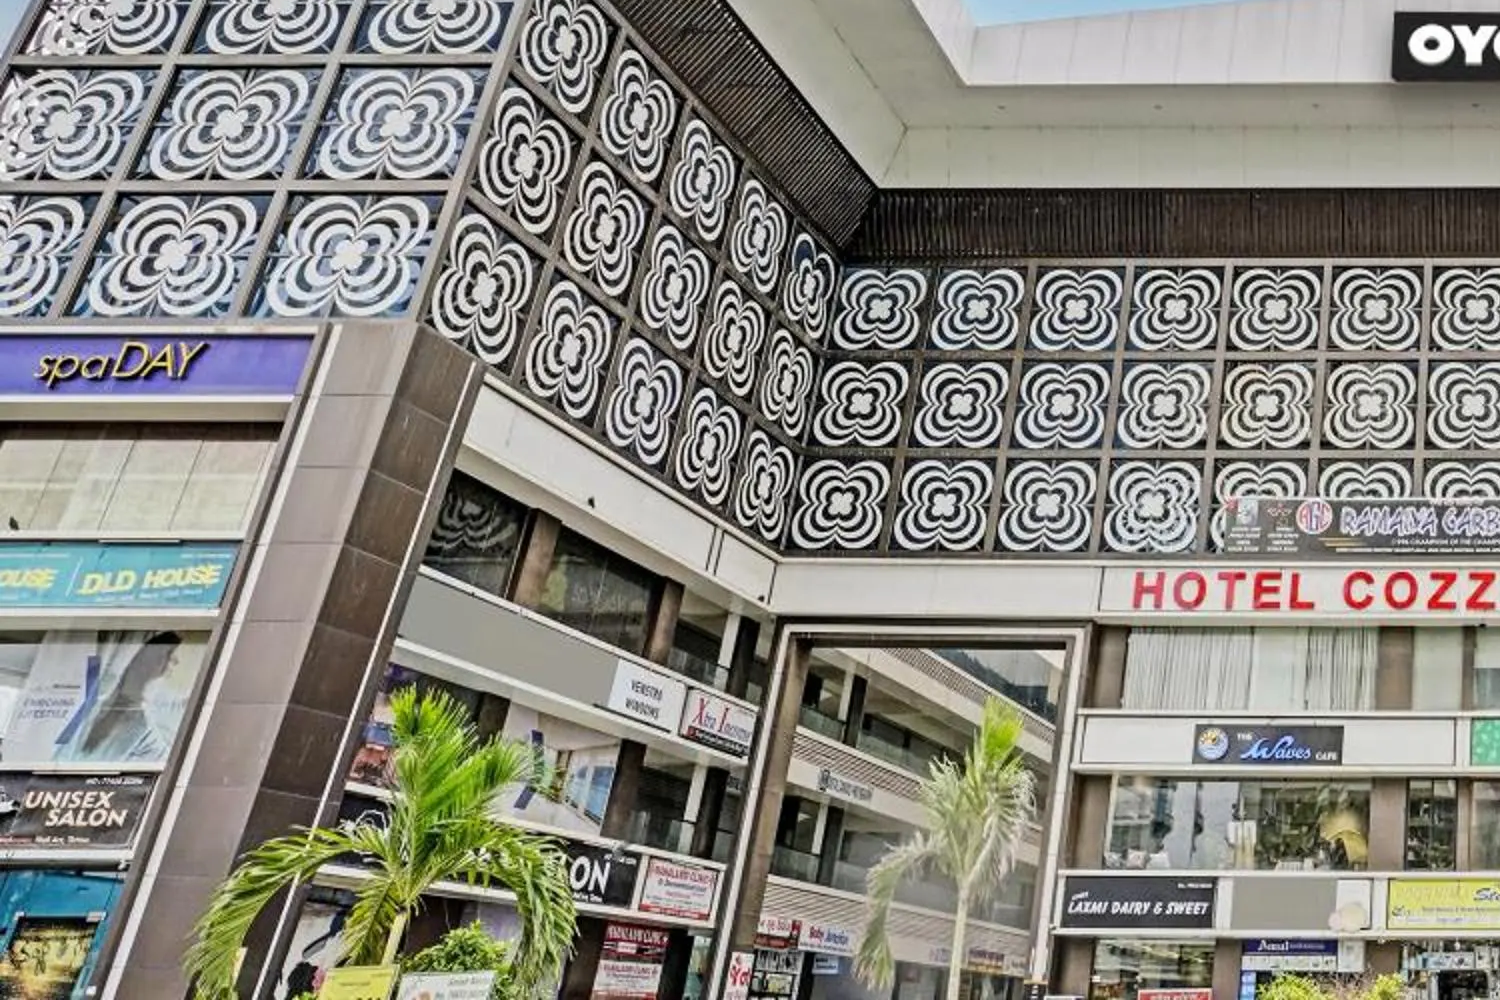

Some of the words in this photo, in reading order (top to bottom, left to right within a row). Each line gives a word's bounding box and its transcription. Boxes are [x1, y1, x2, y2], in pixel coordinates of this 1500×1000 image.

[141, 562, 224, 589] HOUSE
[1132, 571, 1316, 611] HOTEL
[25, 791, 116, 809] UNISEX
[45, 809, 129, 827] SALON
[1067, 901, 1109, 914] LAXMI
[1111, 901, 1151, 915] DAIRY
[1153, 902, 1163, 915] &
[1165, 901, 1210, 915] SWEET
